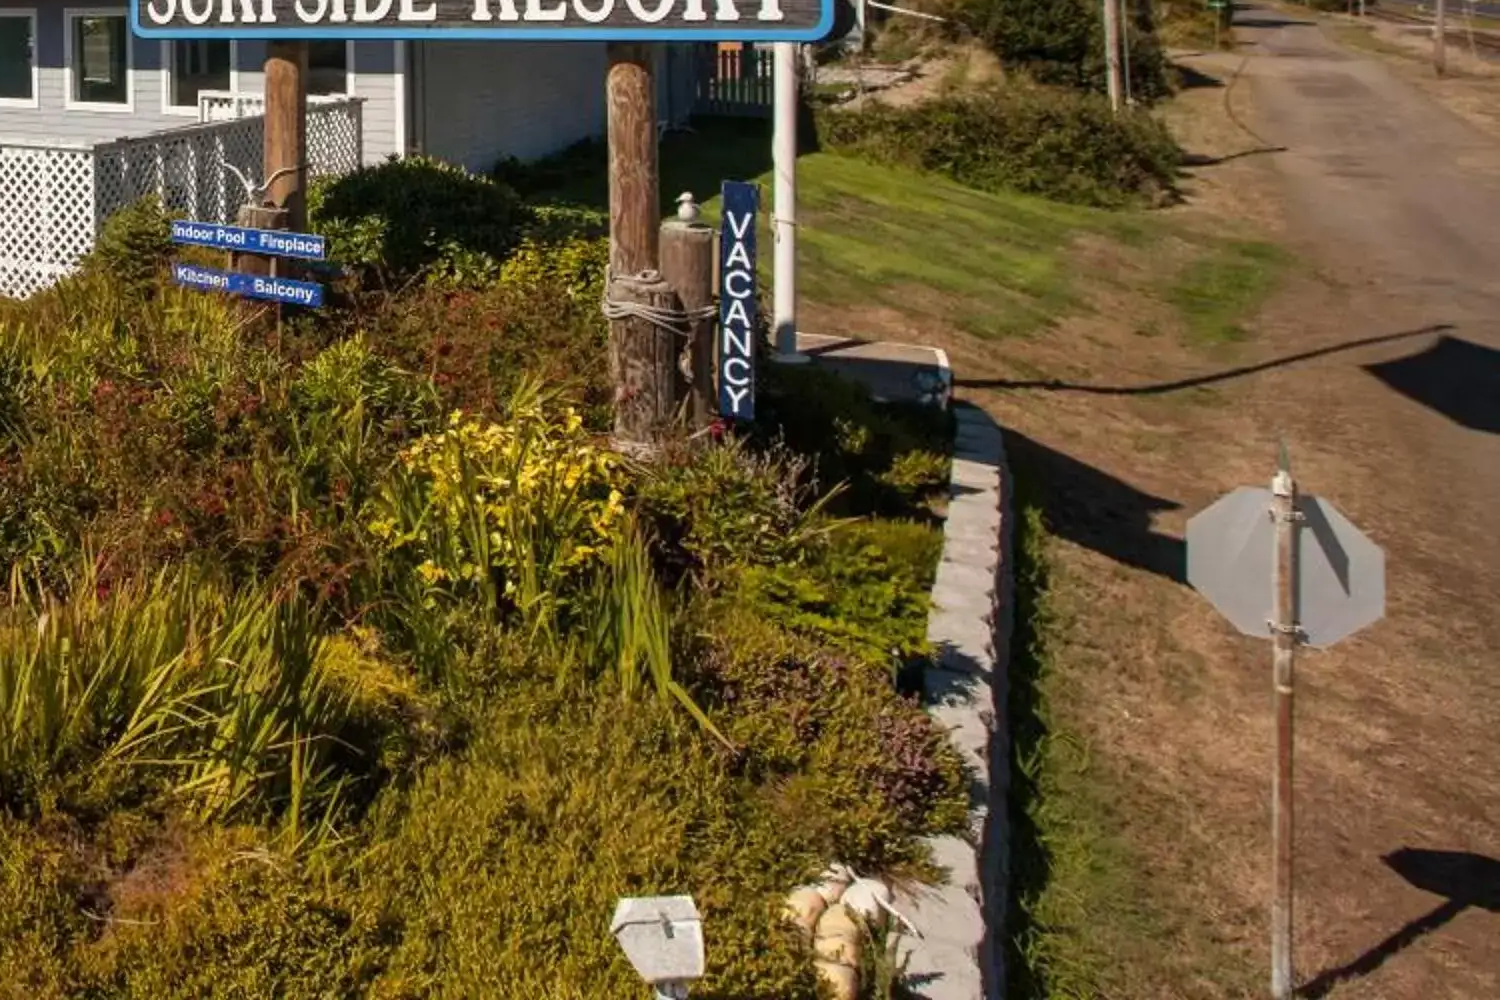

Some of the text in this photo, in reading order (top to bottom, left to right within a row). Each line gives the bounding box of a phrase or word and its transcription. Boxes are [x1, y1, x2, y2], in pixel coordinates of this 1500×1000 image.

[172, 224, 214, 241] Indoor
[217, 229, 245, 244] Pool
[260, 234, 321, 254] Fireplace
[177, 267, 229, 287] Kitchen
[253, 279, 314, 302] Balcony
[723, 210, 753, 414] VACANCY
